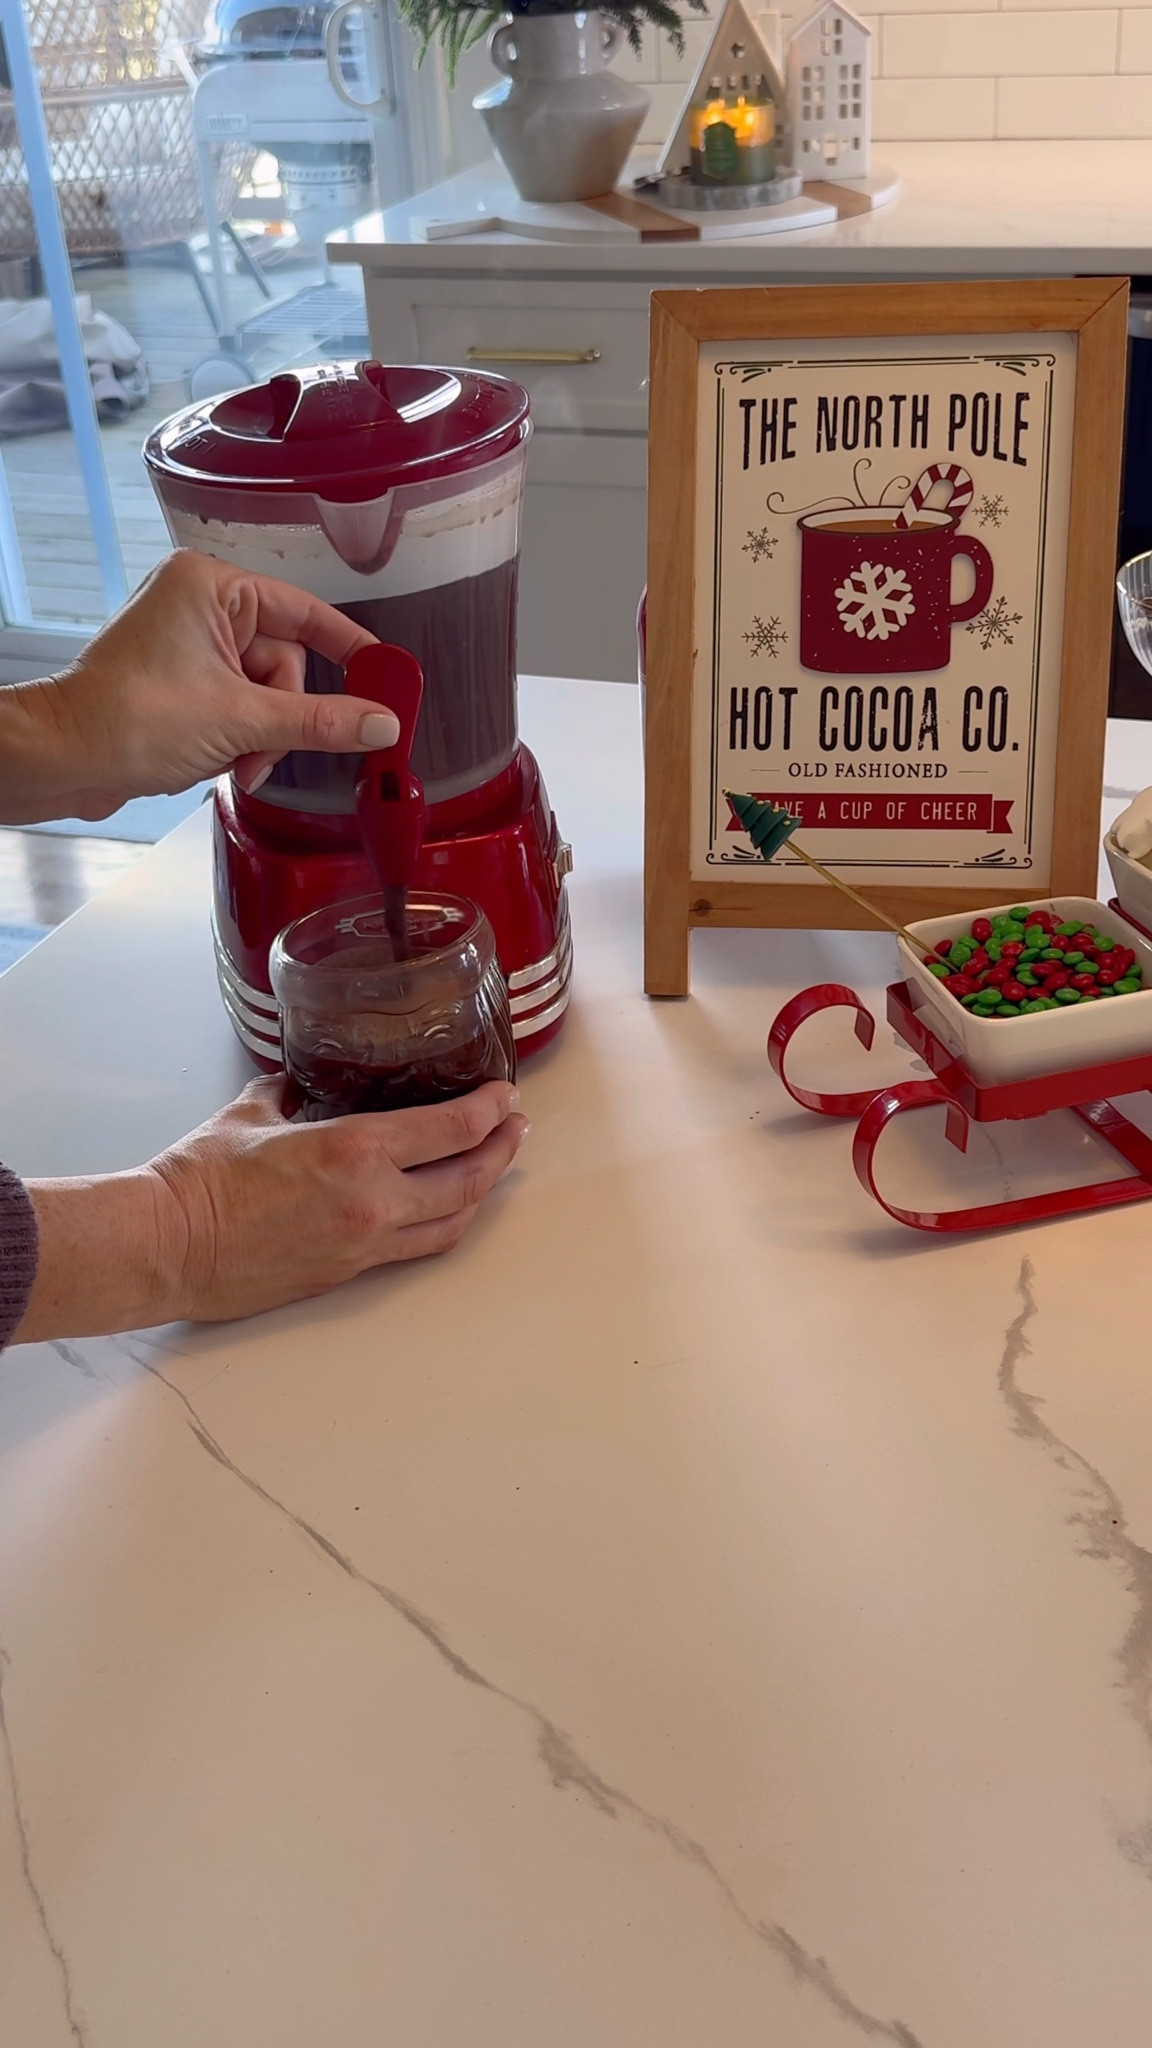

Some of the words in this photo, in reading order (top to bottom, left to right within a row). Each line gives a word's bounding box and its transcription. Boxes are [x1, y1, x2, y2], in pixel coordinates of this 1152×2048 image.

[739, 397, 798, 471] THE
[816, 393, 930, 454] NORTH
[948, 391, 1031, 467] POLE
[729, 685, 799, 751] HOT
[819, 685, 939, 753] COCOA
[962, 685, 1020, 753] CO.
[788, 762, 828, 778] OLD
[834, 762, 949, 779] FASHIONED
[817, 801, 827, 819] A
[840, 801, 872, 820] CUP
[886, 801, 907, 820] OF
[921, 802, 977, 820] CHEER
